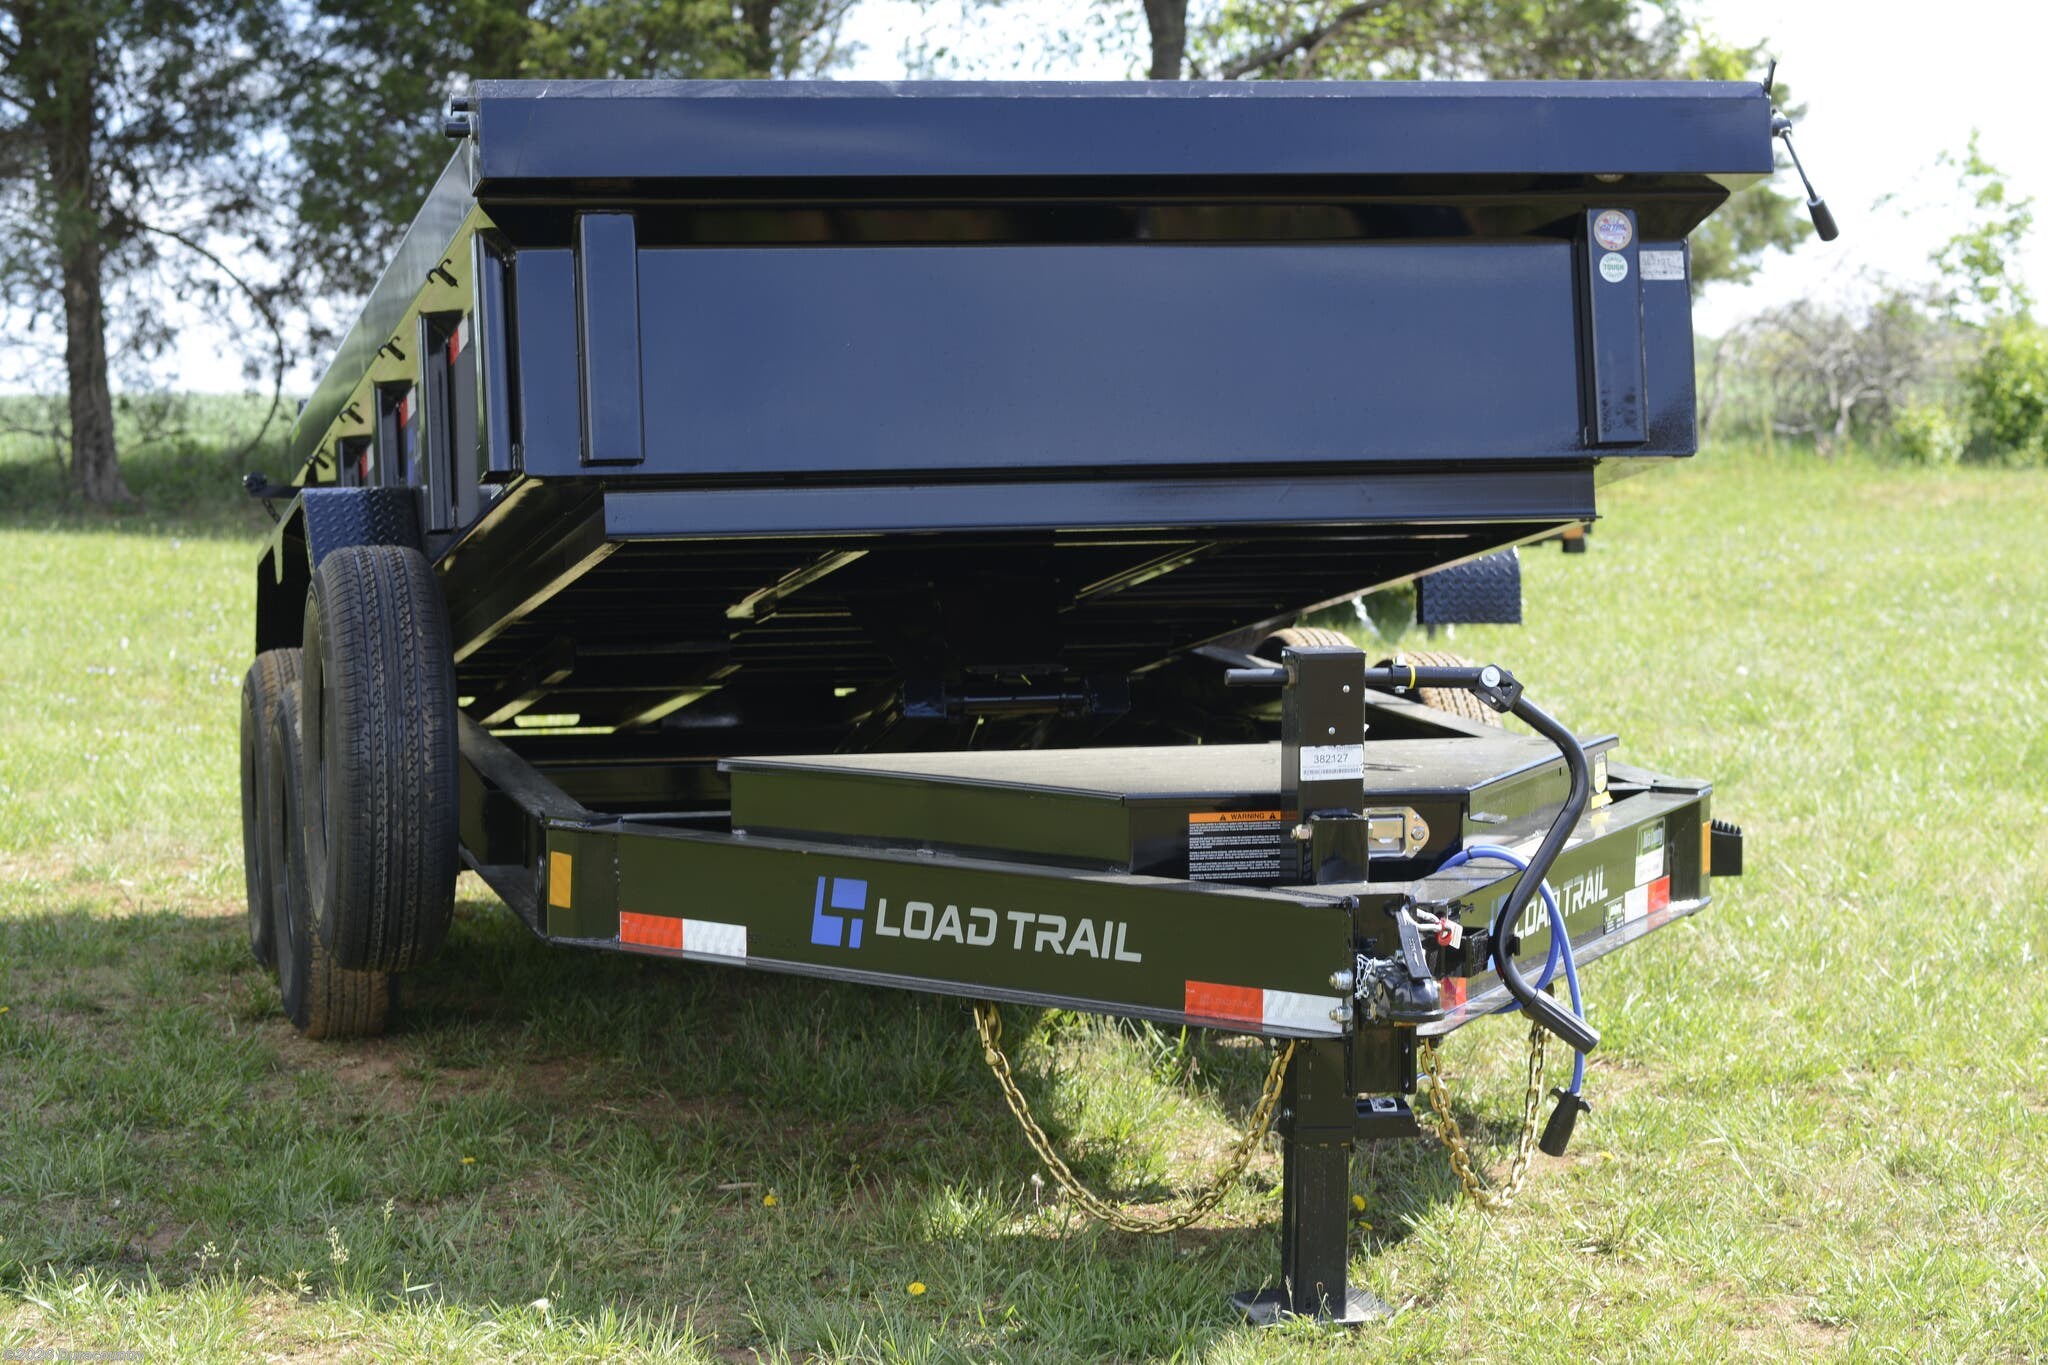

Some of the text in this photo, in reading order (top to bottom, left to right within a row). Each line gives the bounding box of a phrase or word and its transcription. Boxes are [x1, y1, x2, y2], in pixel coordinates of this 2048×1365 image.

[1313, 753, 1349, 764] 382127
[1230, 812, 1265, 821] WARNING
[1563, 864, 1609, 918] TRAIL
[876, 897, 1142, 963] LOAD TRAIL
